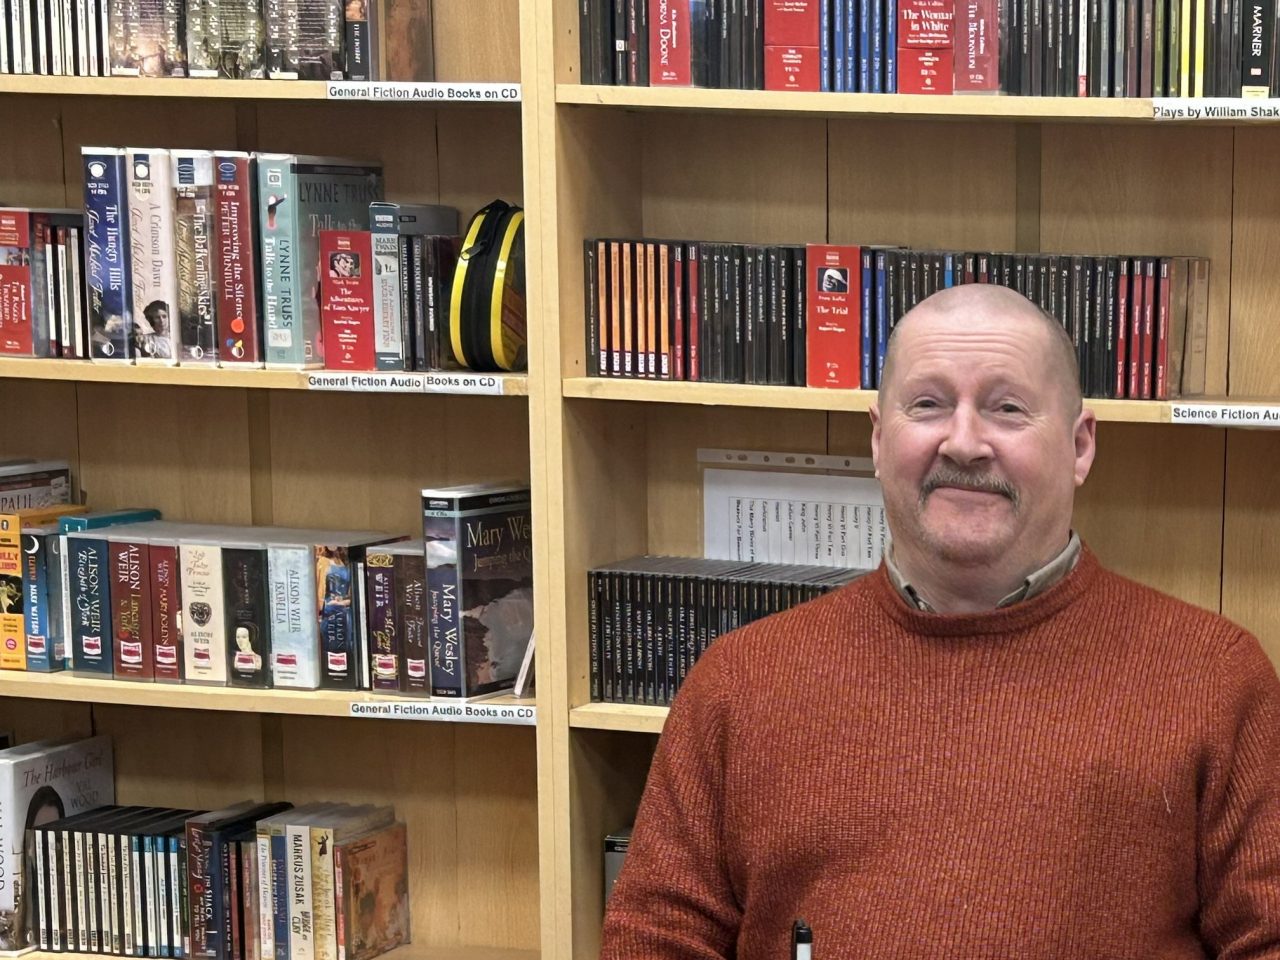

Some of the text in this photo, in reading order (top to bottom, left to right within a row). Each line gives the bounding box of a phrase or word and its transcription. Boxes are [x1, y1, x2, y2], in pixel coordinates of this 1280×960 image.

[1251, 5, 1263, 57] MARNER
[329, 86, 518, 98] General Fiction Audio Books on CD
[1152, 106, 1184, 119] Plays
[1187, 106, 1201, 119] by
[1205, 106, 1247, 117] William
[300, 183, 340, 203] LYNNE
[105, 205, 117, 225] The
[220, 201, 231, 235] PETER
[105, 227, 119, 263] Hungry
[150, 214, 164, 288] Crimson Dawn
[229, 202, 243, 280] Improving the
[109, 267, 122, 291] Hills
[264, 237, 278, 329] Talk the Hand
[279, 239, 293, 328] LYNNE TRUSS
[816, 306, 849, 315] The Trial
[308, 376, 422, 388] General Fiction Audio
[426, 376, 496, 387] Books on CD
[1173, 407, 1218, 419] Science
[1221, 409, 1260, 420] Fiction
[466, 521, 503, 555] Mary
[118, 545, 141, 590] ALISON WEIR
[87, 547, 101, 633] ALISON WEIR
[275, 581, 287, 625] ISABELLA
[289, 569, 302, 634] ALISON WEIR
[373, 573, 384, 608] WEIR
[413, 580, 424, 611] Alison
[131, 594, 141, 640] Lancaster
[440, 583, 459, 676] Mary Wesley
[351, 703, 533, 718] General Fiction Audio Books on CD
[24, 769, 42, 788] The
[293, 834, 305, 905] MARKUS ZUSAK
[205, 889, 213, 920] SHACK
[291, 916, 301, 935] CLAY
